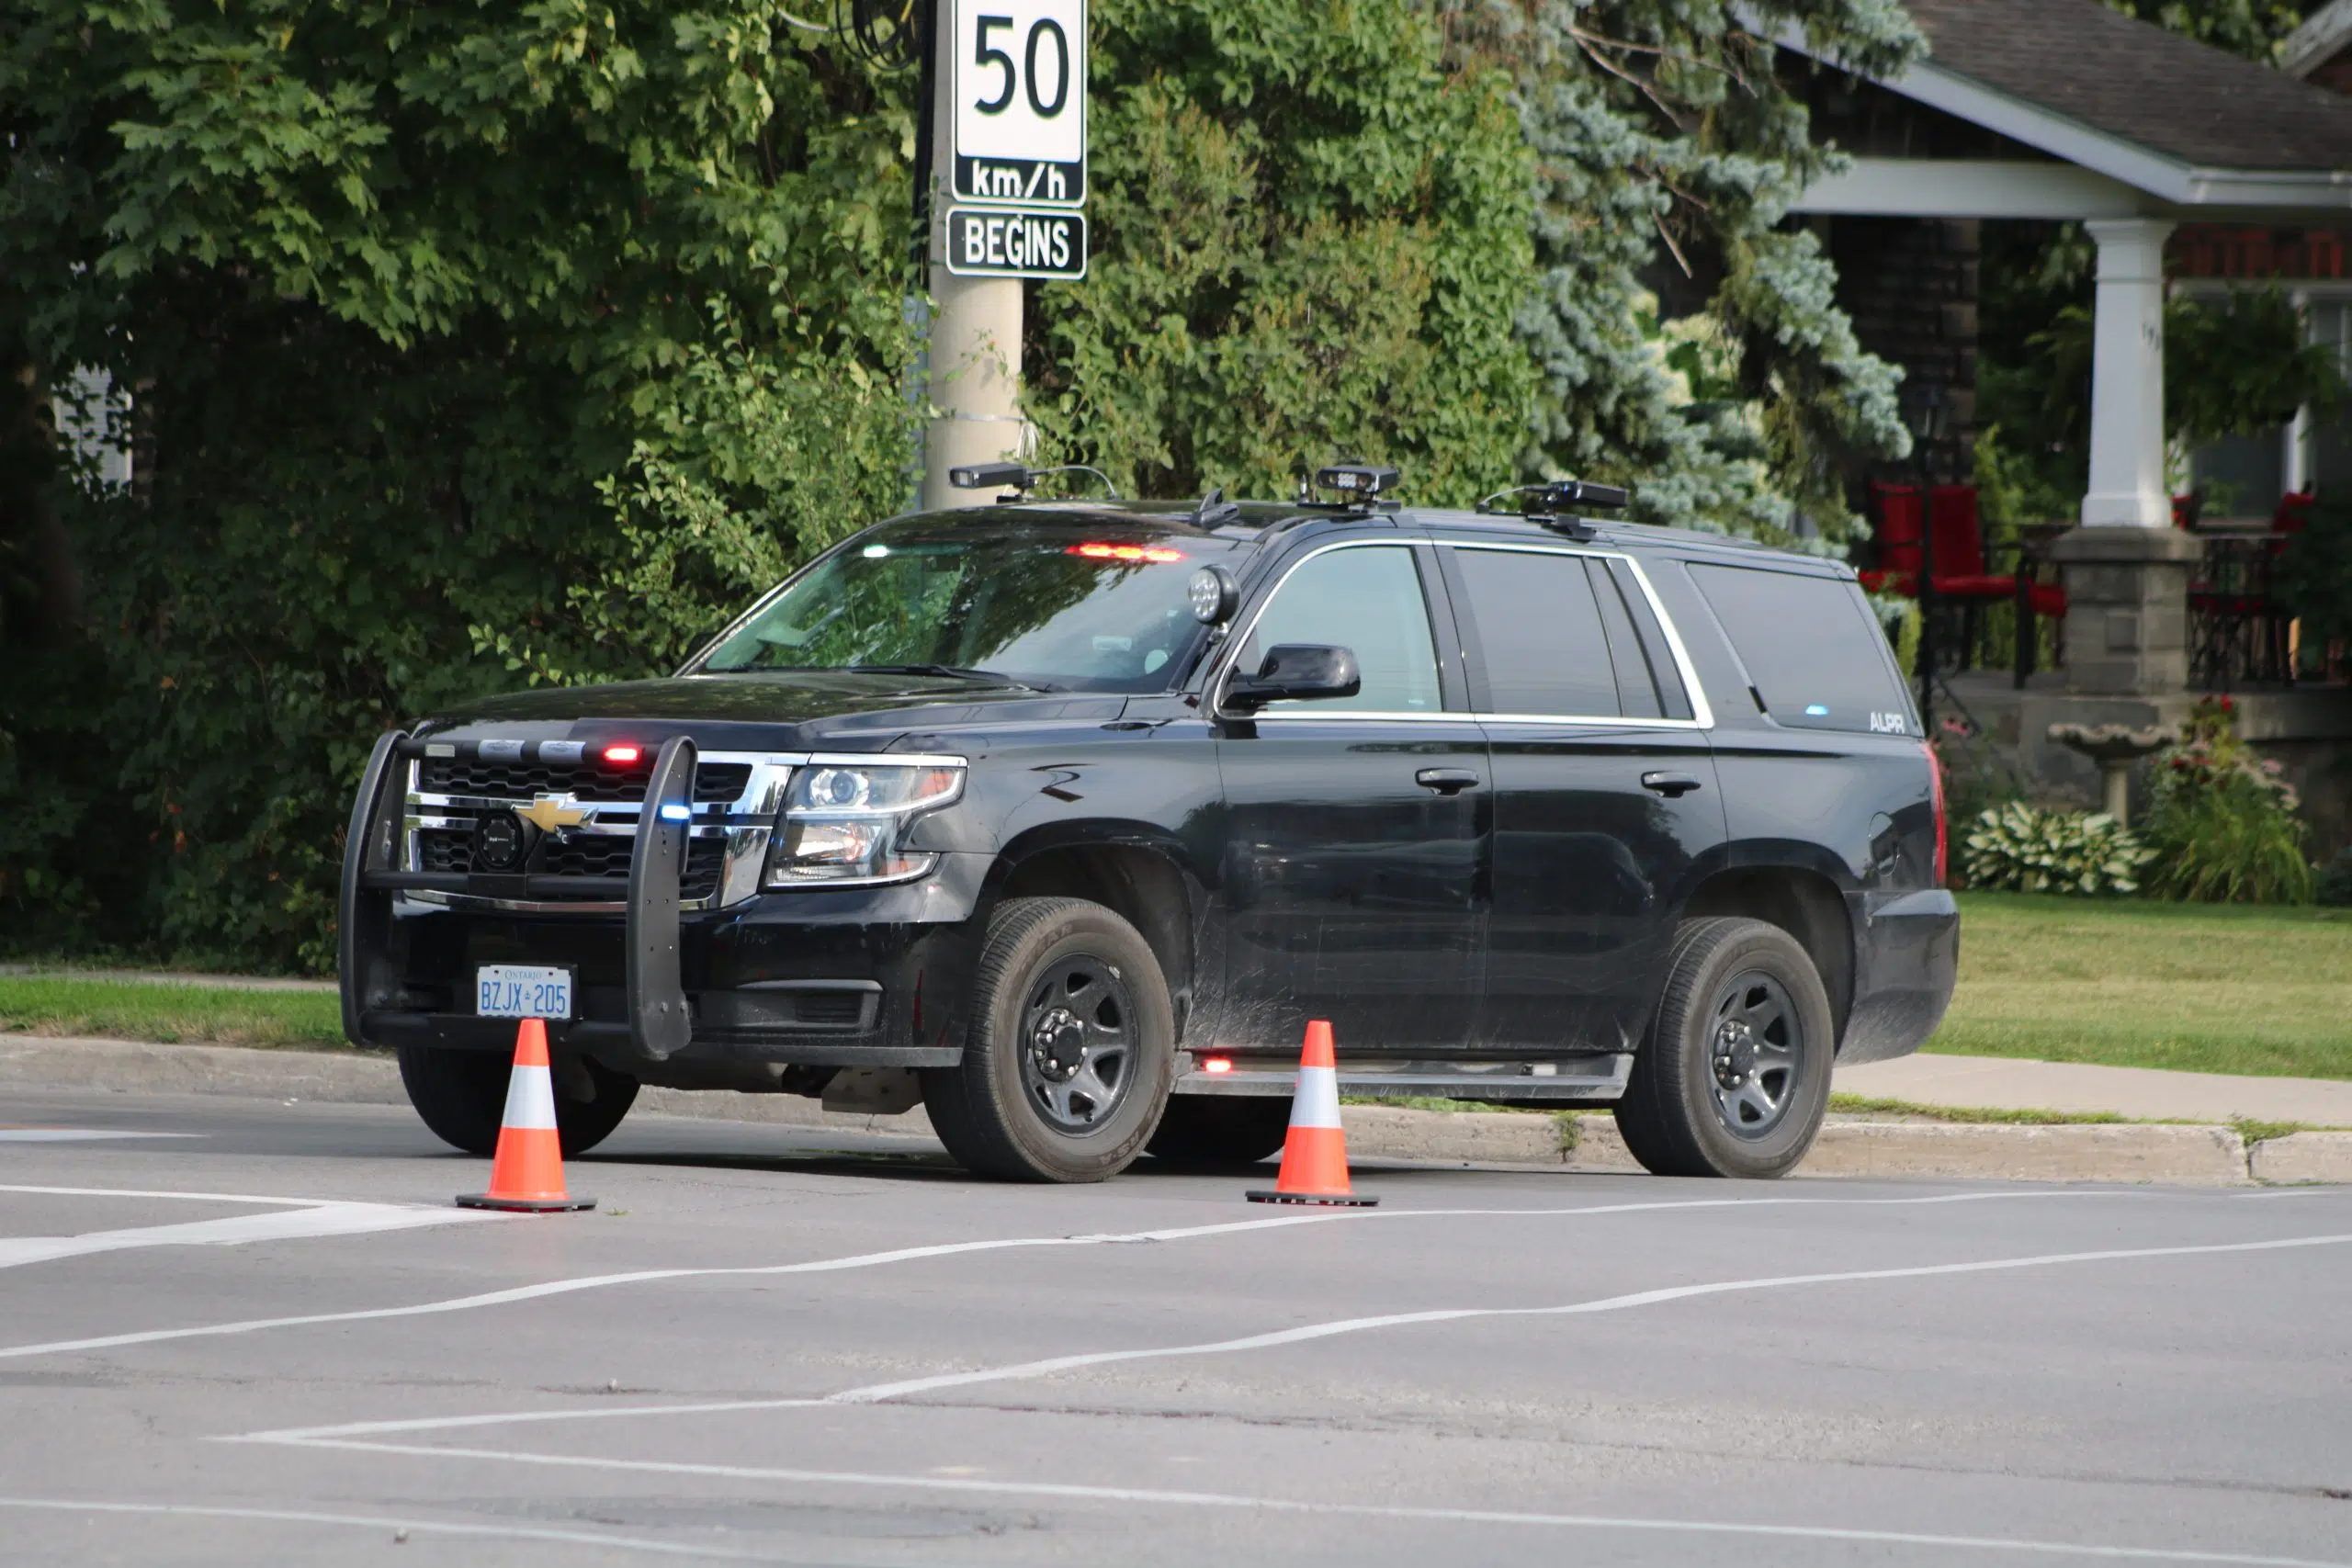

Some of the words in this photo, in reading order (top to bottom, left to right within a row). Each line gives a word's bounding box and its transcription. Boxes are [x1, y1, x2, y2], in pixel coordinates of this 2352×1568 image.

[974, 15, 1069, 120] 50
[972, 159, 1067, 200] km/h
[965, 216, 1070, 268] BEGINS
[1870, 711, 1905, 734] ALPR
[504, 969, 543, 981] ONTARIO
[481, 981, 522, 1011] BZJX
[534, 984, 567, 1013] 205
